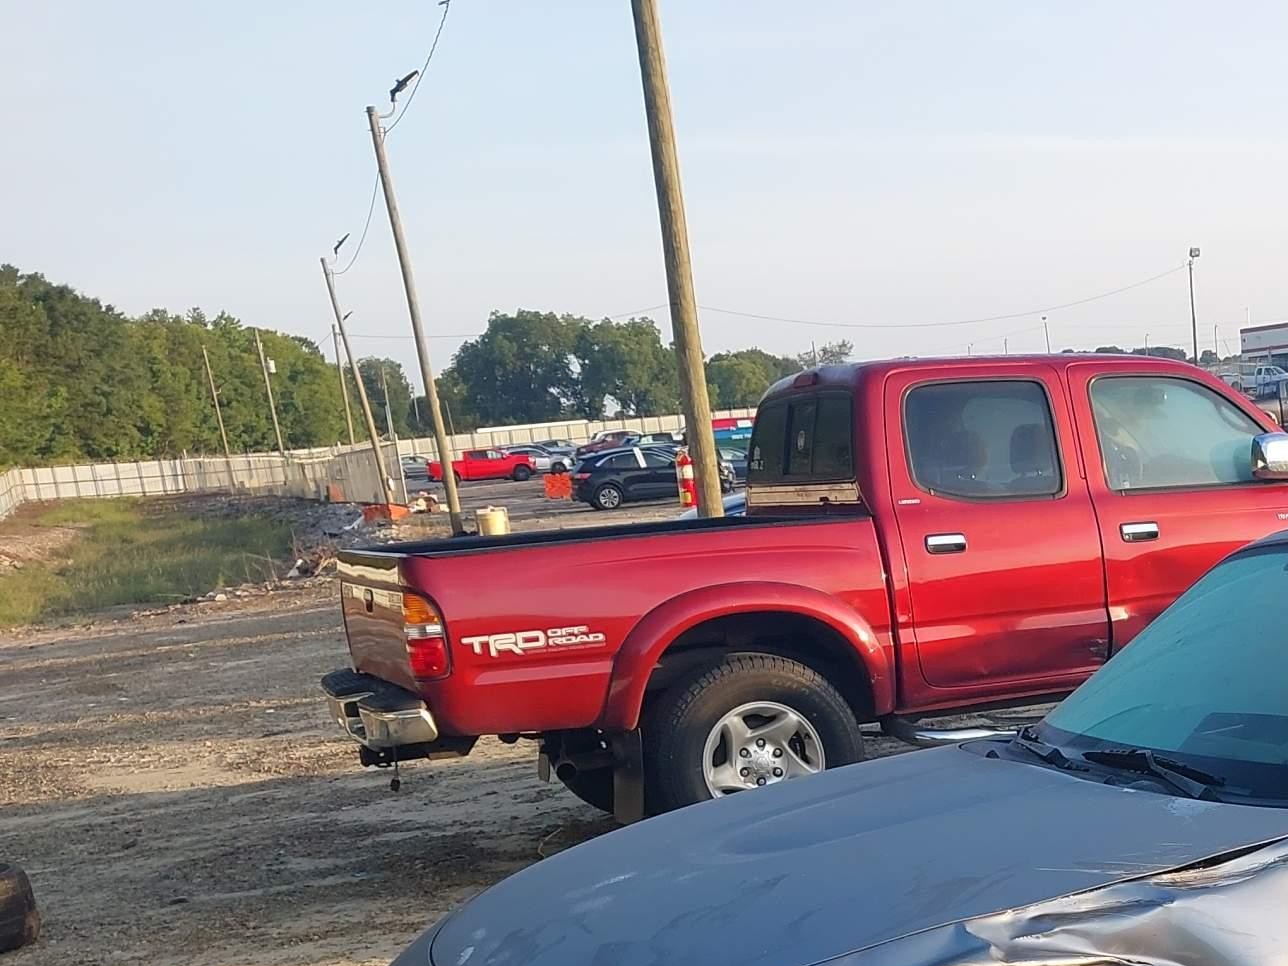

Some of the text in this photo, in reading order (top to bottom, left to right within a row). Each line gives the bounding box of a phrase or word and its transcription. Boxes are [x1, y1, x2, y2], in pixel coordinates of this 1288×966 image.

[461, 630, 546, 657] TRD
[547, 626, 589, 636] OFF
[548, 633, 605, 646] ROAD
